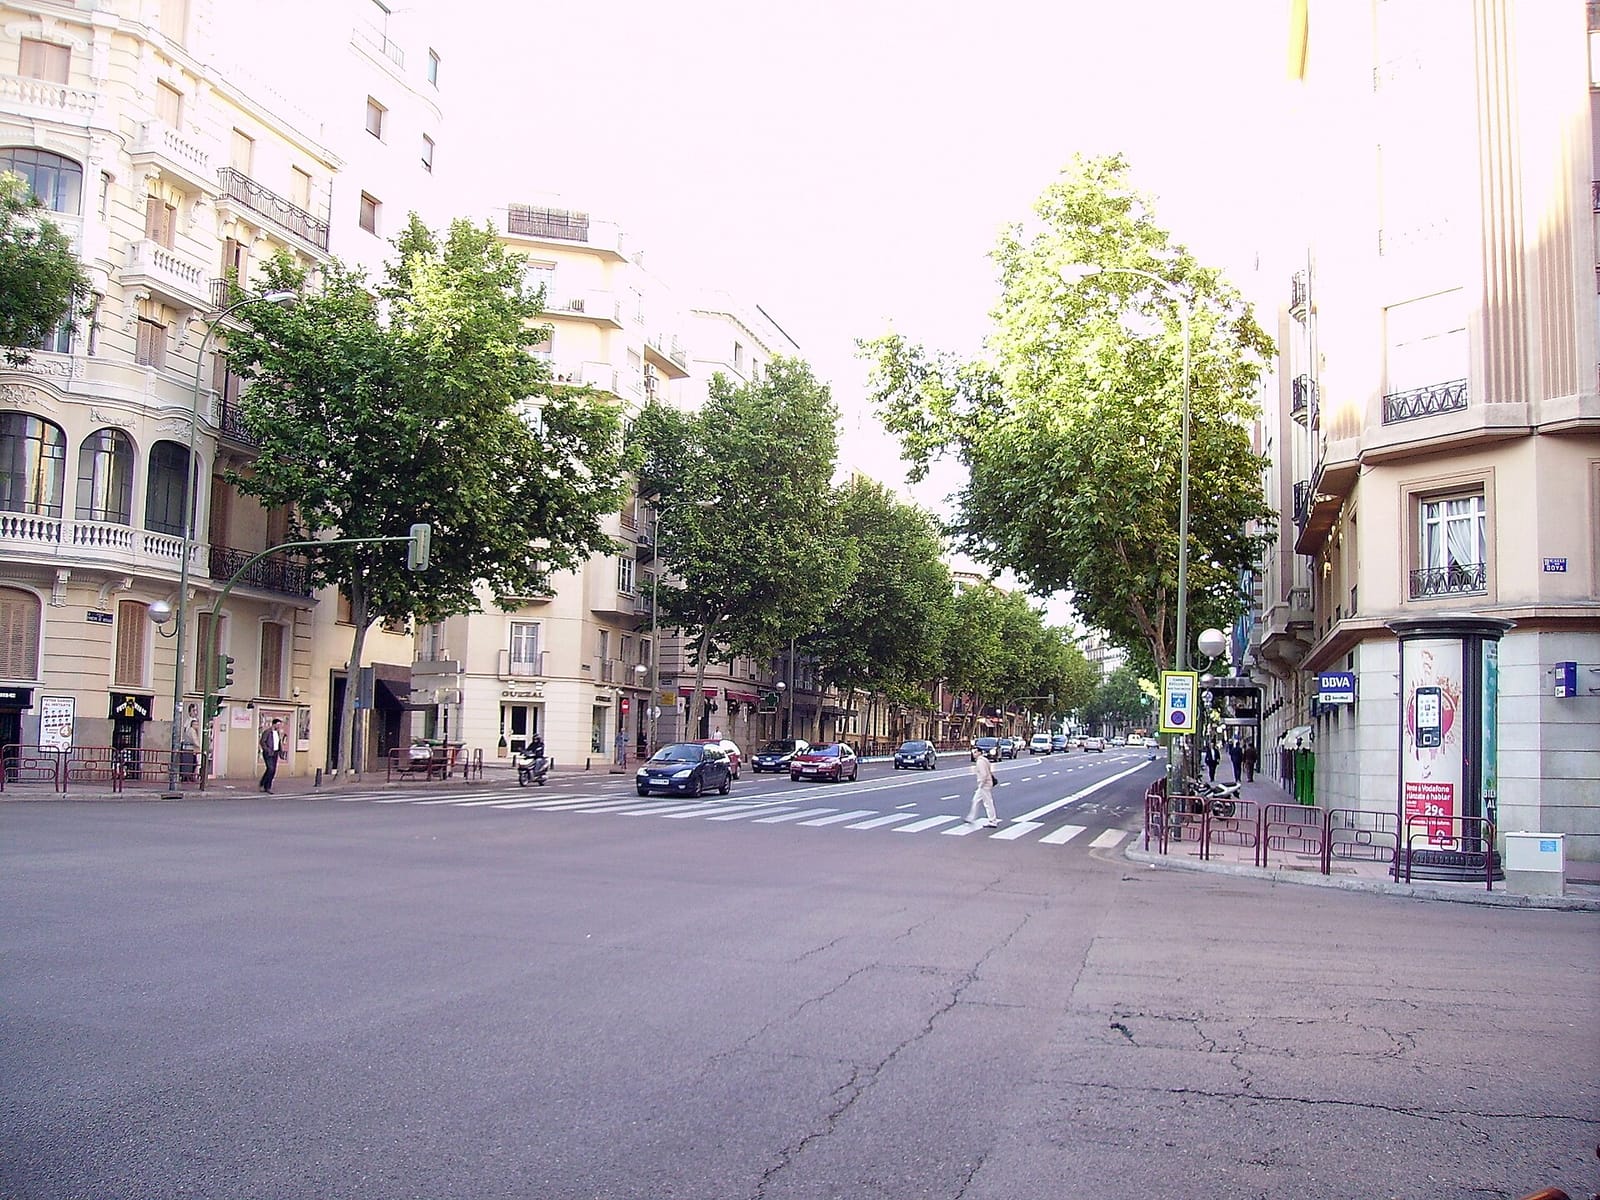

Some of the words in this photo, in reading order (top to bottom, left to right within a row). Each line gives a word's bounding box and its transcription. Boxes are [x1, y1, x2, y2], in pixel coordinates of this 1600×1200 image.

[1321, 676, 1351, 688] BBVA
[1422, 784, 1450, 792] Vodafone
[1430, 793, 1451, 801] hablar
